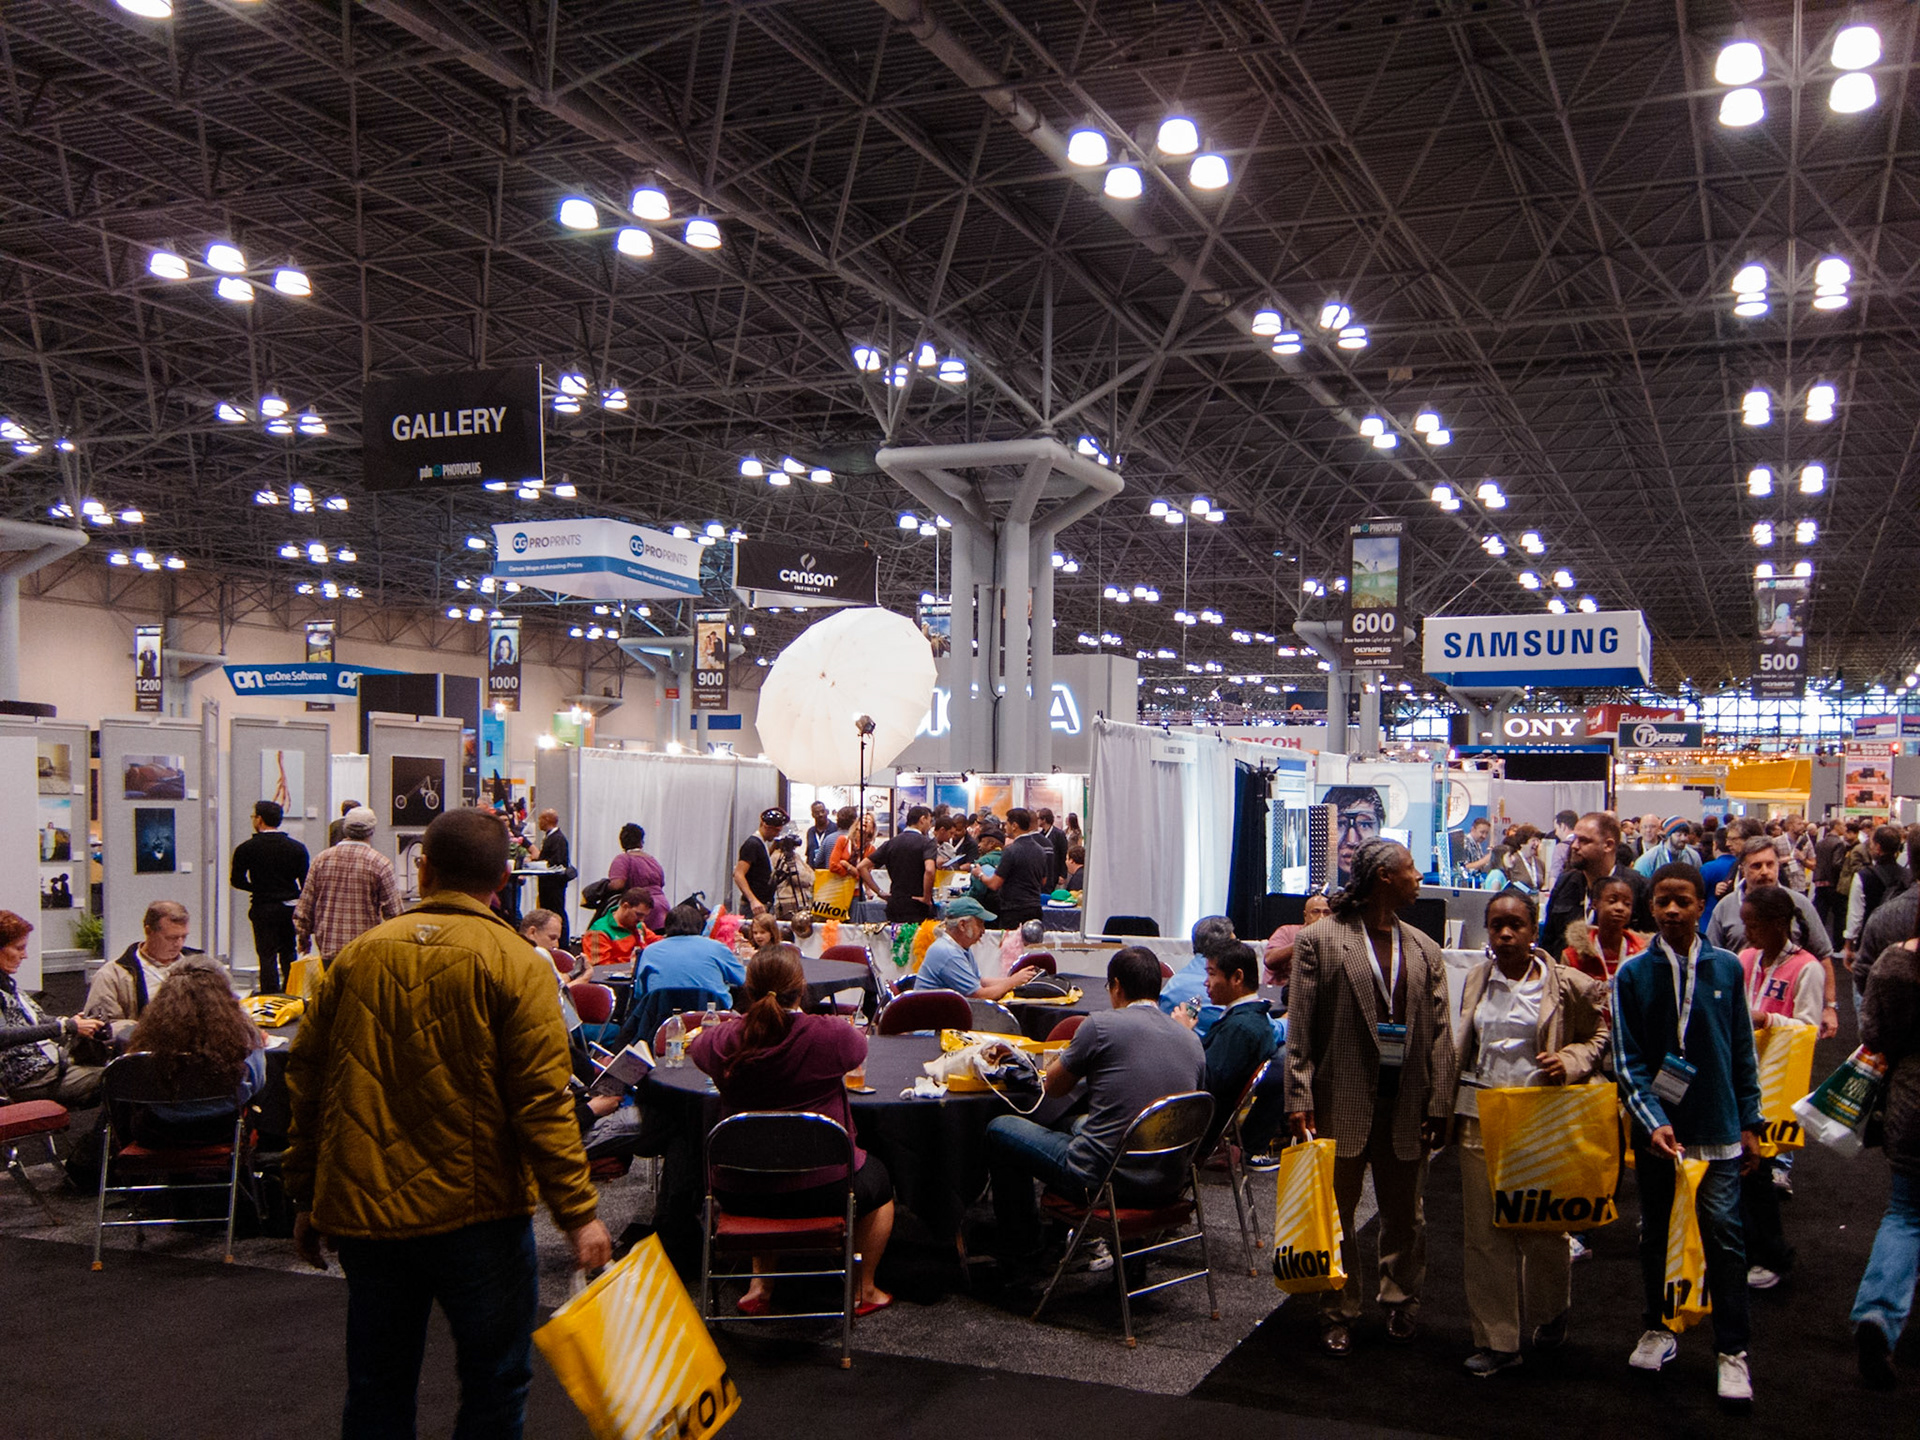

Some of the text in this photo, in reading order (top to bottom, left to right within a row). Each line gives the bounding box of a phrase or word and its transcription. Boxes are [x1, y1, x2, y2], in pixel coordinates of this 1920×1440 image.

[391, 406, 507, 441] GALLERY
[442, 462, 482, 477] PHOTOPLUS
[1369, 523, 1403, 533] PHOTOPLUS
[546, 563, 566, 571] Amazing
[794, 585, 821, 593] INFINITY
[1352, 613, 1396, 633] 600
[1443, 627, 1618, 659] SAMSUNG
[1760, 653, 1799, 671] 500
[291, 671, 327, 681] Software
[490, 676, 519, 689] 1000
[698, 672, 724, 686] 900
[136, 679, 161, 691] 1200
[1765, 979, 1789, 1000] H
